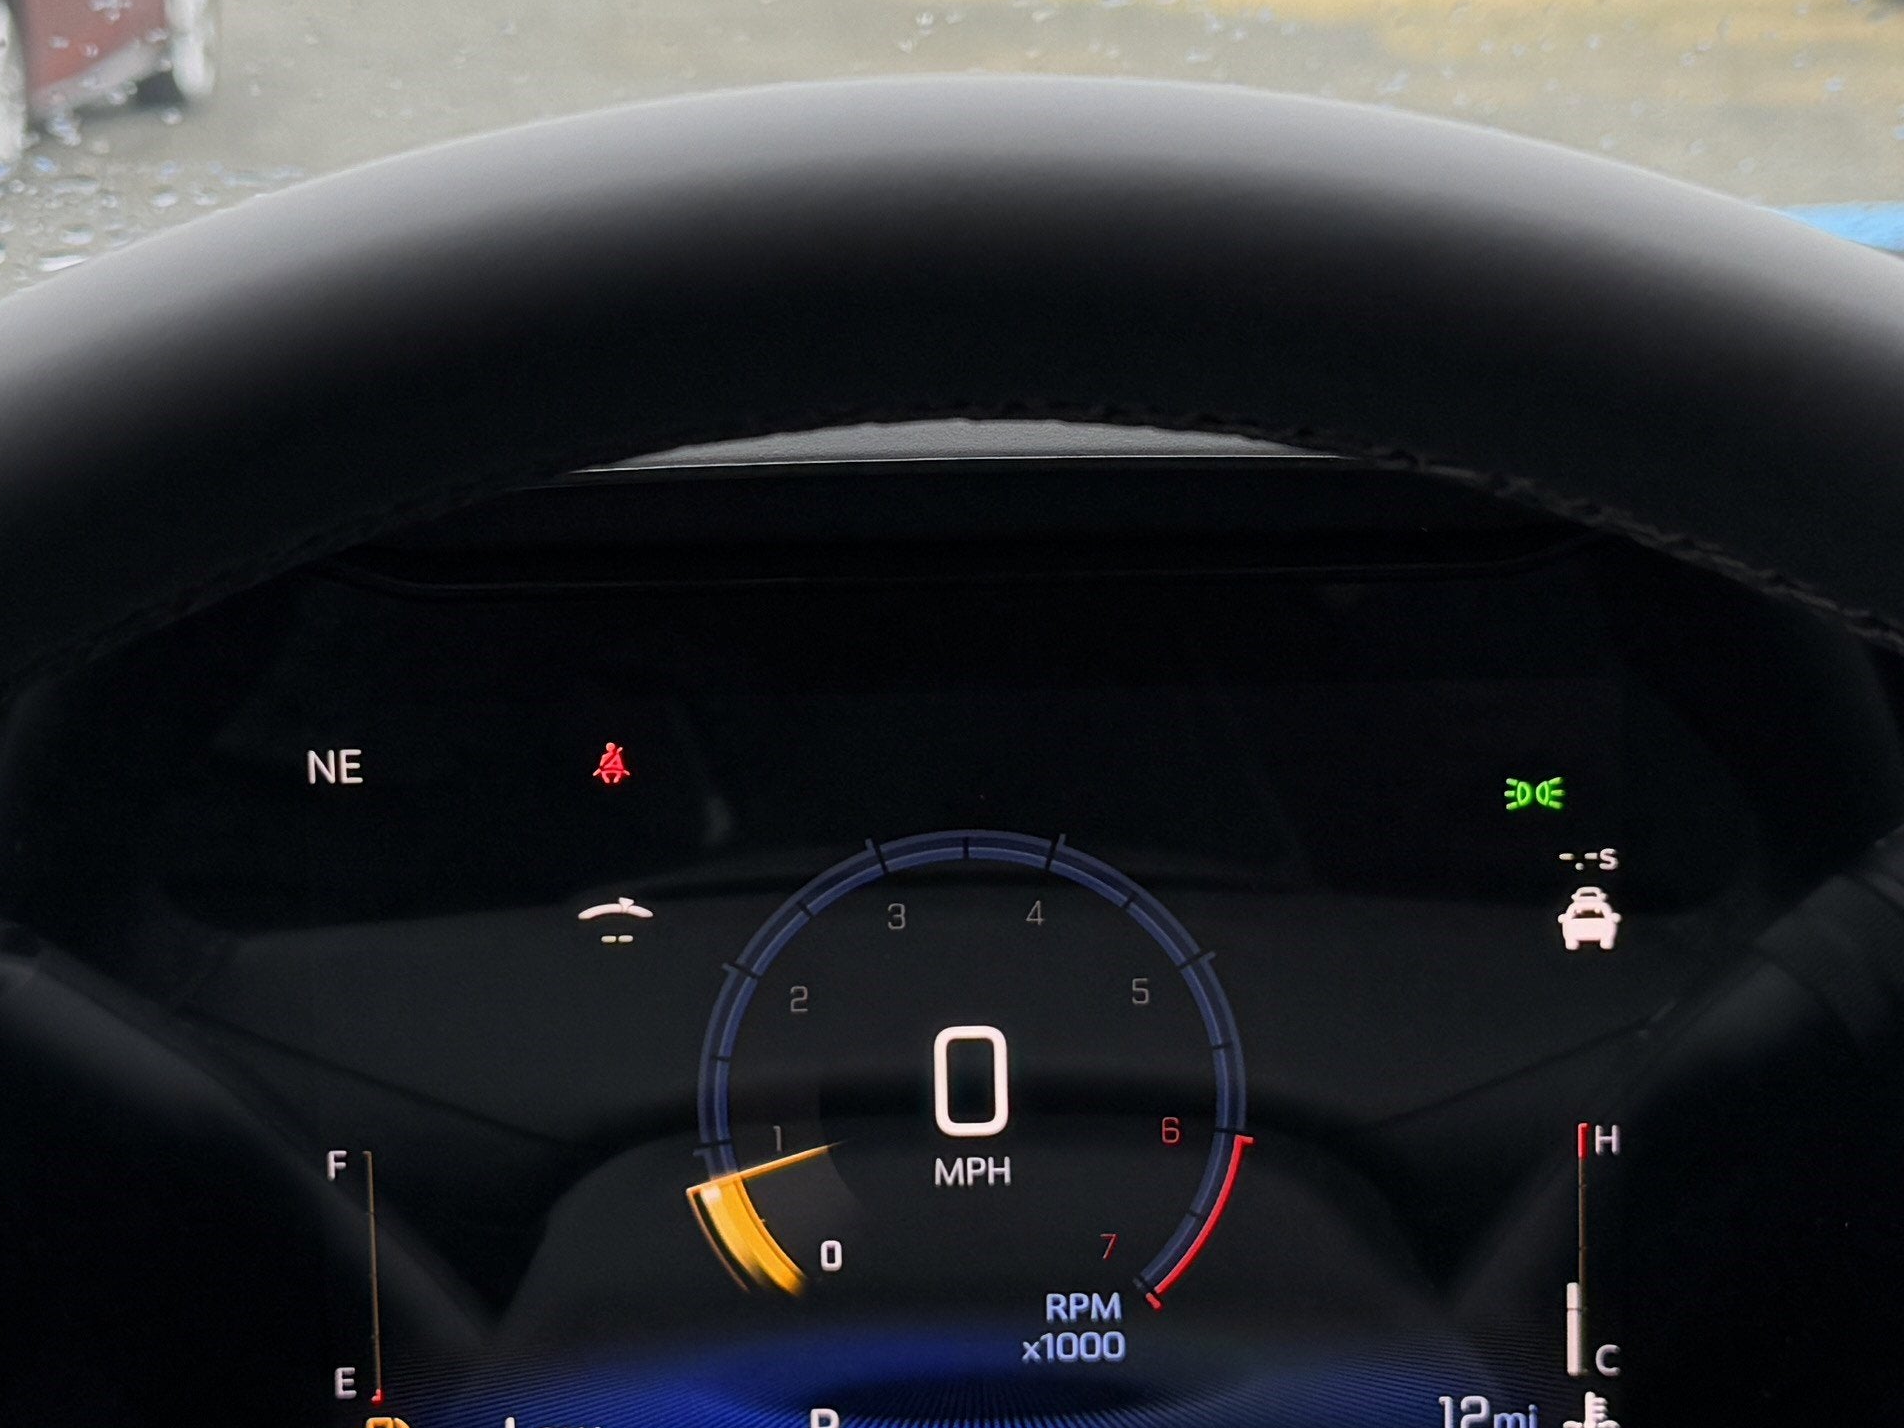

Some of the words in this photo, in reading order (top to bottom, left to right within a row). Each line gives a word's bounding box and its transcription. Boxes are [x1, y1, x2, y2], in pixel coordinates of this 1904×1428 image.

[307, 748, 364, 784] NE
[887, 902, 907, 931] 3
[1026, 900, 1045, 927] 4
[790, 986, 809, 1013] 2
[1132, 978, 1150, 1005] 5
[933, 1025, 1009, 1137] 0
[772, 1125, 783, 1151] 1
[1161, 1117, 1180, 1144] 6
[1595, 1124, 1621, 1156] H
[326, 1150, 348, 1181] F
[934, 1157, 1012, 1187] MPH
[820, 1240, 843, 1272] 0
[1100, 1233, 1118, 1260] 7
[1046, 1293, 1122, 1323] RPM
[1022, 1331, 1126, 1363] x1000
[1596, 1344, 1621, 1376] C
[334, 1368, 357, 1399] E
